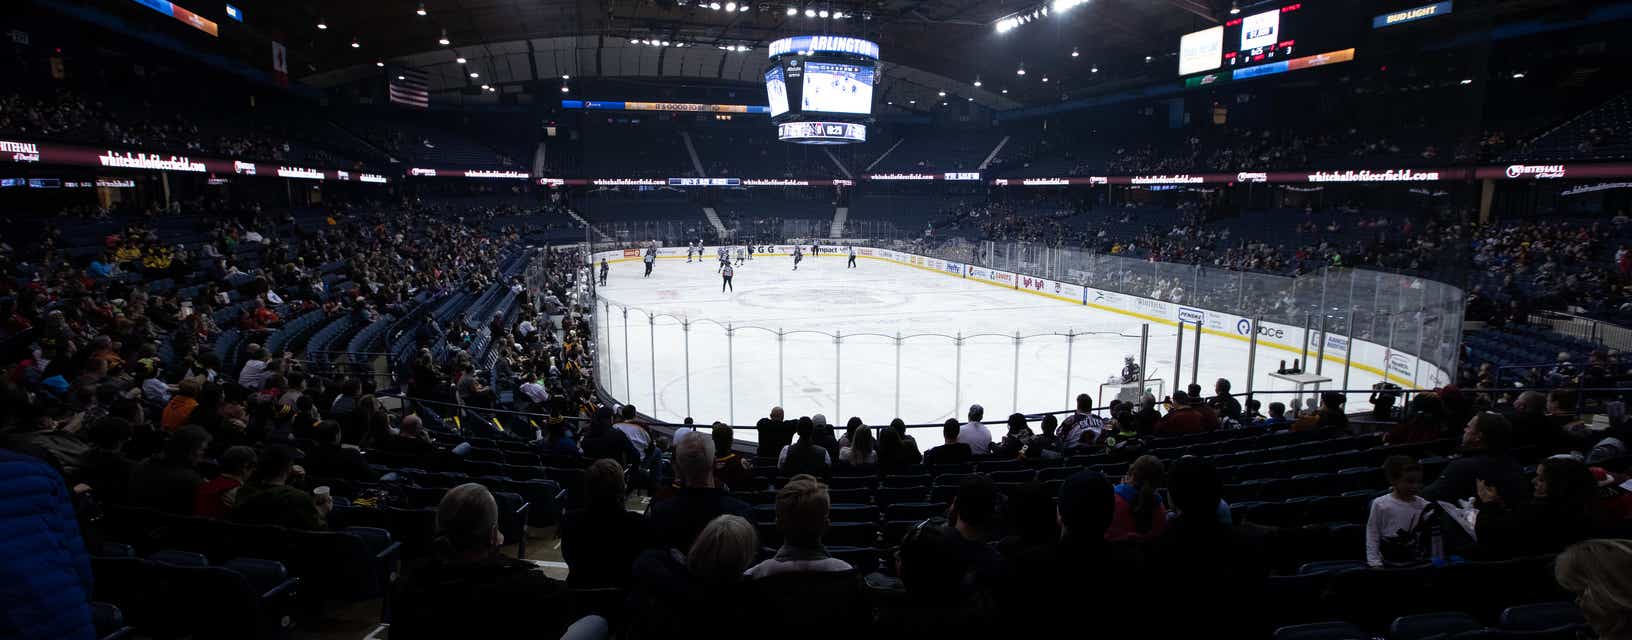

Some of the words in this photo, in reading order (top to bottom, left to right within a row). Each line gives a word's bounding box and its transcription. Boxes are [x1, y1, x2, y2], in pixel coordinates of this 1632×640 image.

[1386, 12, 1407, 24] BUD
[1407, 5, 1437, 19] LIGHT
[809, 36, 873, 57] ARLINGTON
[1308, 169, 1439, 182] whitehallofdeerfield.com
